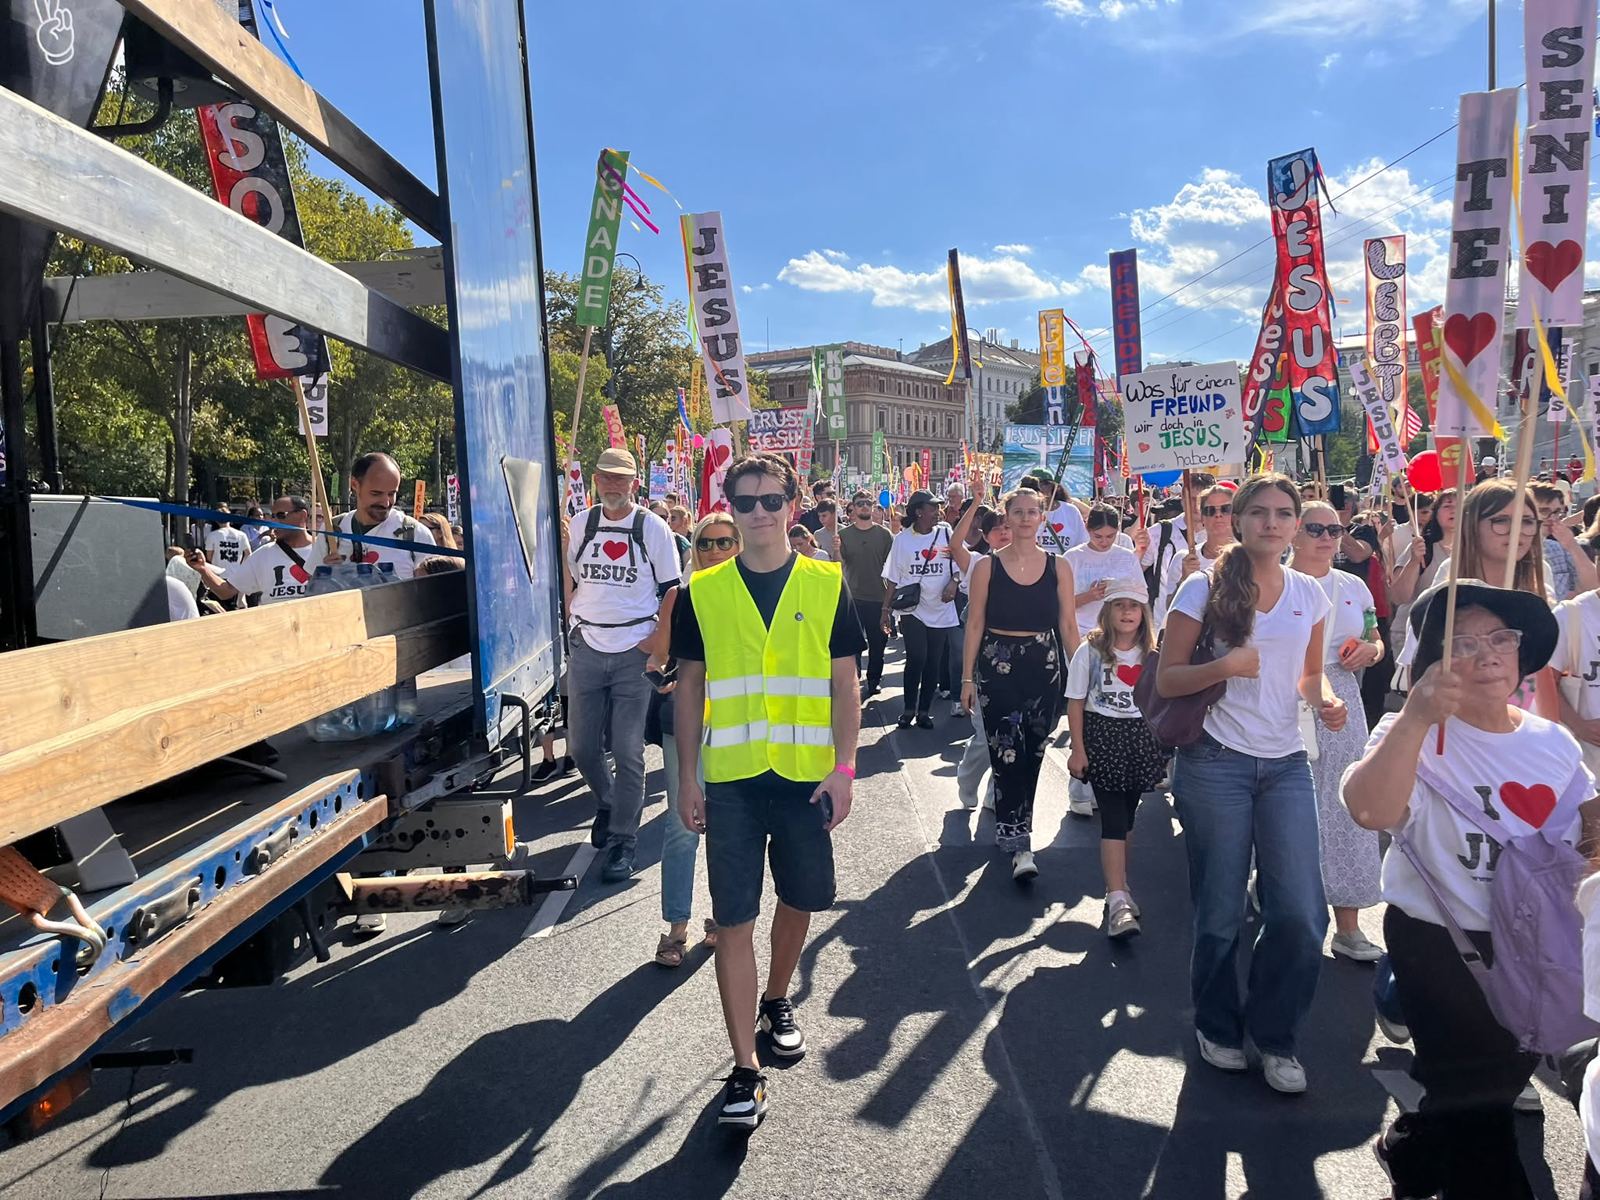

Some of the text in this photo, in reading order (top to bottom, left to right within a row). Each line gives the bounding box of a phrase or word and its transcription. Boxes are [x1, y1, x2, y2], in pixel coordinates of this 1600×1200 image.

[1528, 26, 1590, 224] SENI
[1449, 158, 1508, 279] TE
[584, 168, 622, 308] GNADE
[1276, 158, 1333, 422] JESUS
[692, 227, 742, 398] JESUS
[1043, 313, 1064, 425] Freun
[692, 369, 701, 413] JESUS
[826, 350, 845, 429] KÖNIG
[1126, 374, 1235, 402] Was für einen
[1151, 393, 1226, 417] FREUND
[1357, 370, 1399, 459] JESUS
[1047, 426, 1095, 446] SIEER
[1134, 417, 1204, 433] wir doch in
[1158, 424, 1222, 449] JESUS
[750, 427, 803, 451] JESU
[873, 437, 881, 480] JESUS
[1174, 442, 1229, 467] haben!
[666, 458, 674, 483] YOU
[592, 543, 602, 558] I
[914, 551, 920, 561] I
[273, 565, 285, 586] I
[580, 563, 638, 583] JESUS
[908, 563, 944, 575] JESUS
[269, 585, 307, 597] JESU
[1104, 668, 1113, 685] I
[1473, 785, 1500, 820] I
